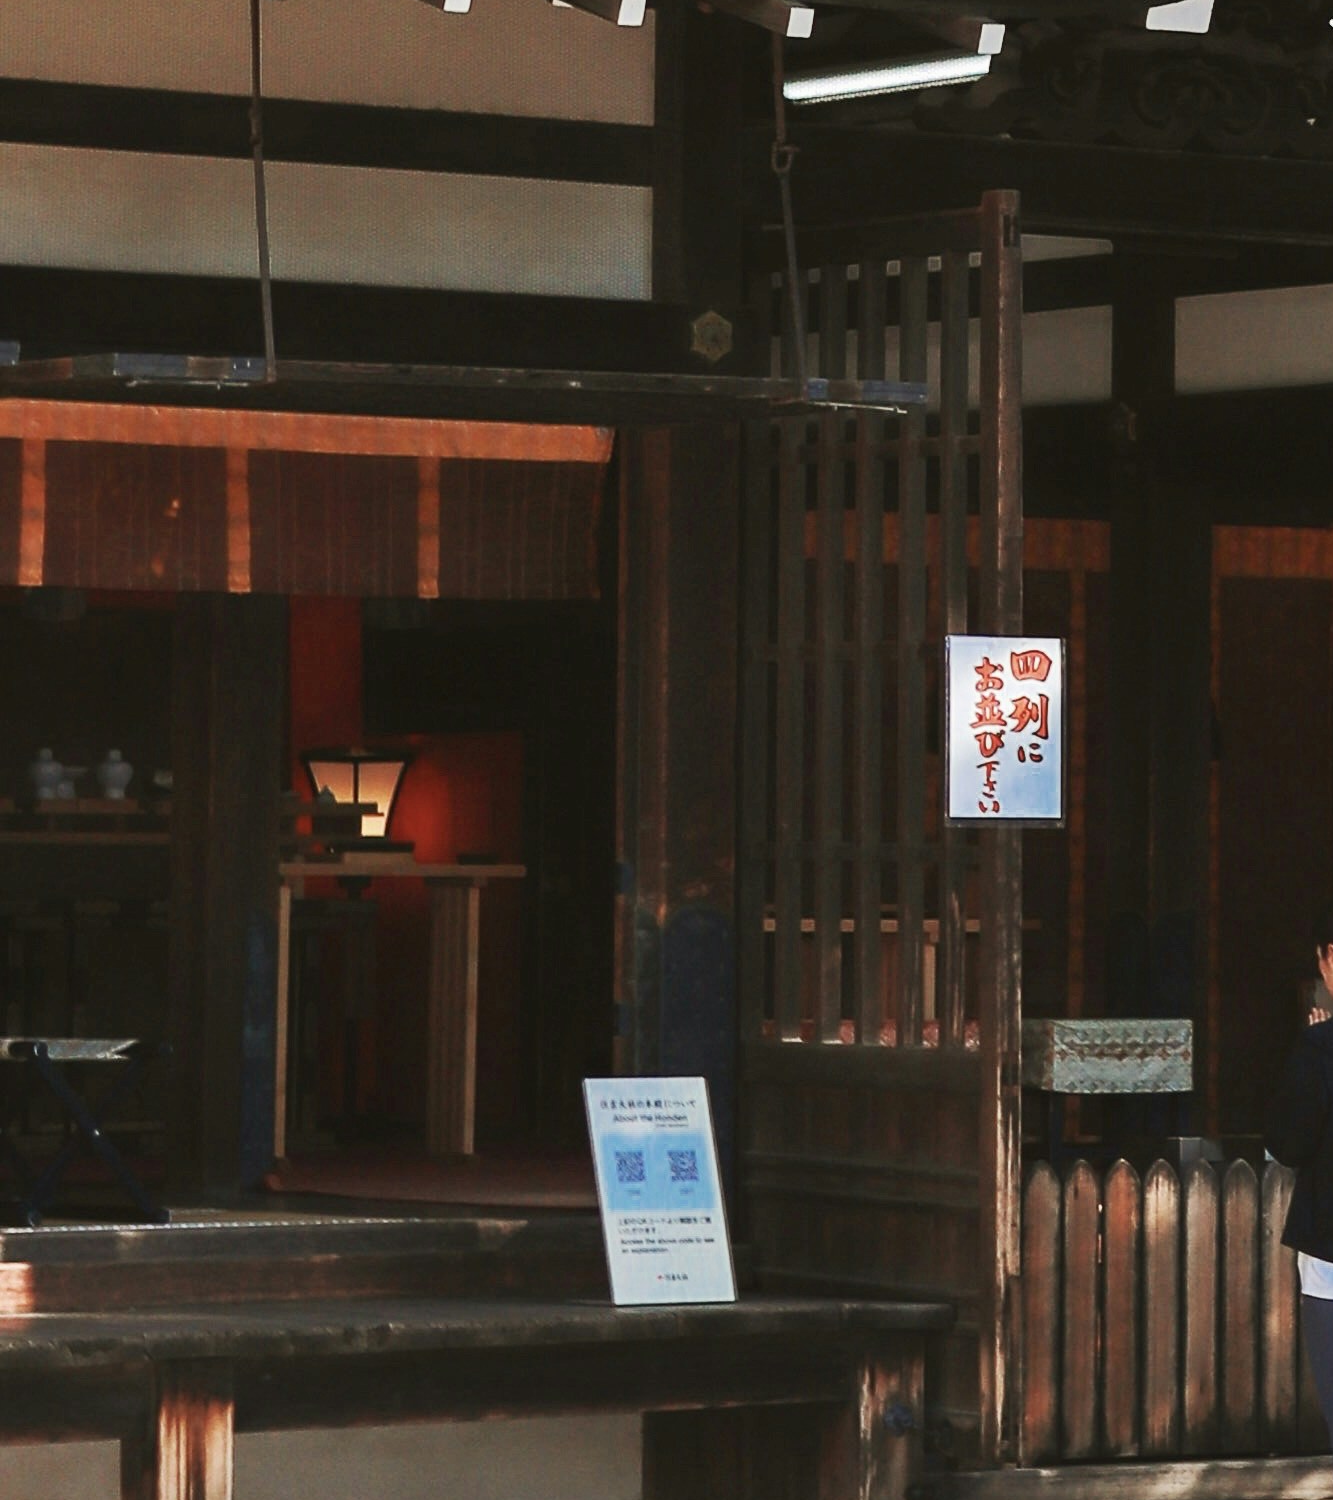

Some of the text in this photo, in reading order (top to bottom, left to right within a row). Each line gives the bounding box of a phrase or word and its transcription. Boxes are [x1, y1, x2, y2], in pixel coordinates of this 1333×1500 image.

[970, 656, 1008, 813] お並び下さい
[1010, 649, 1052, 763] 四列に
[613, 1114, 637, 1122] About
